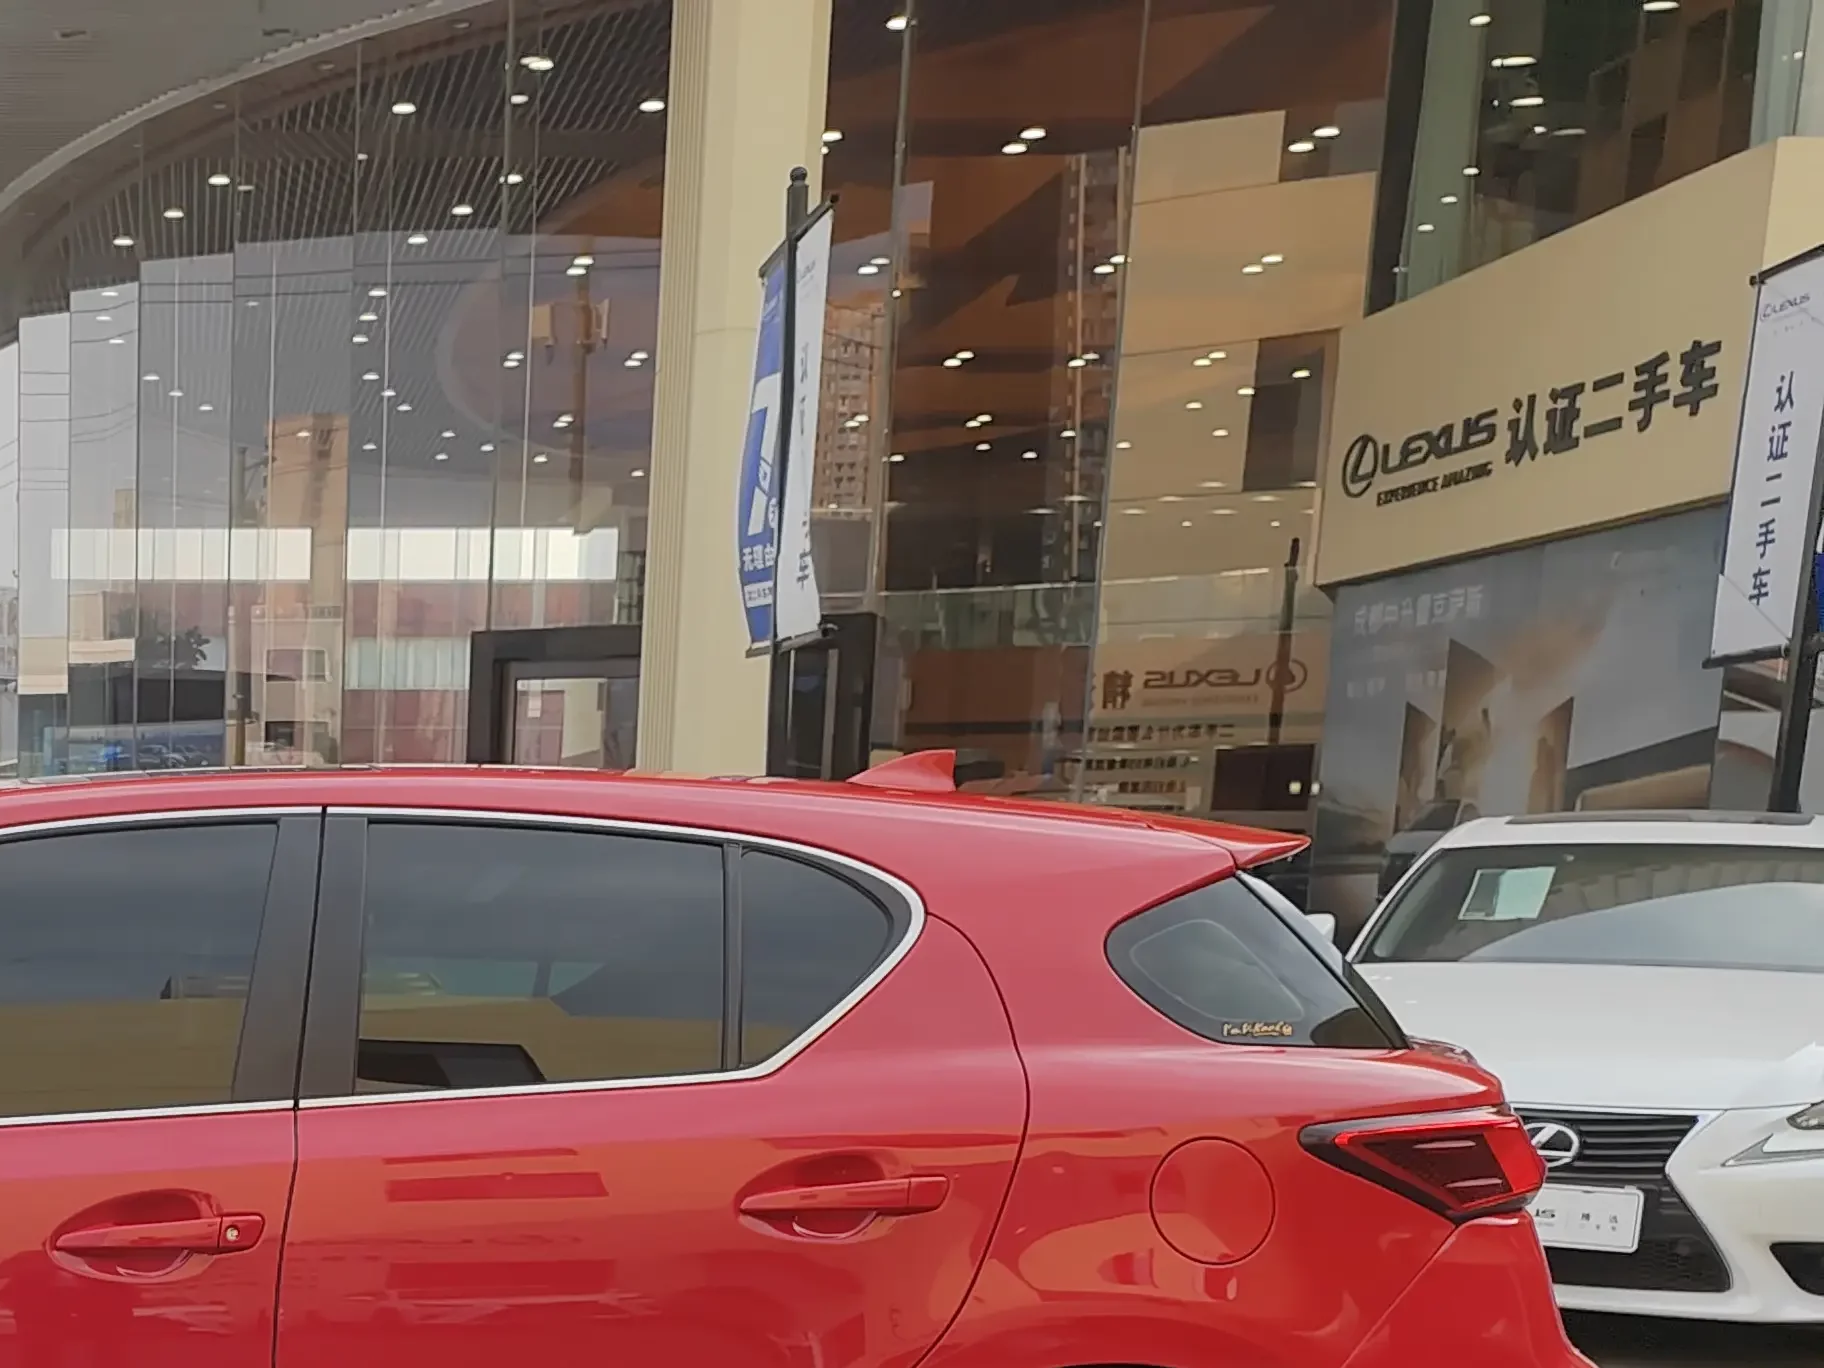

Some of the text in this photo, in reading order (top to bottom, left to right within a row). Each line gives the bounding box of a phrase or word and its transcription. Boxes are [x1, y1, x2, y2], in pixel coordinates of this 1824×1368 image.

[1380, 340, 1722, 475] LEXUS 认证二手车
[1748, 370, 1795, 606] 认证二手车
